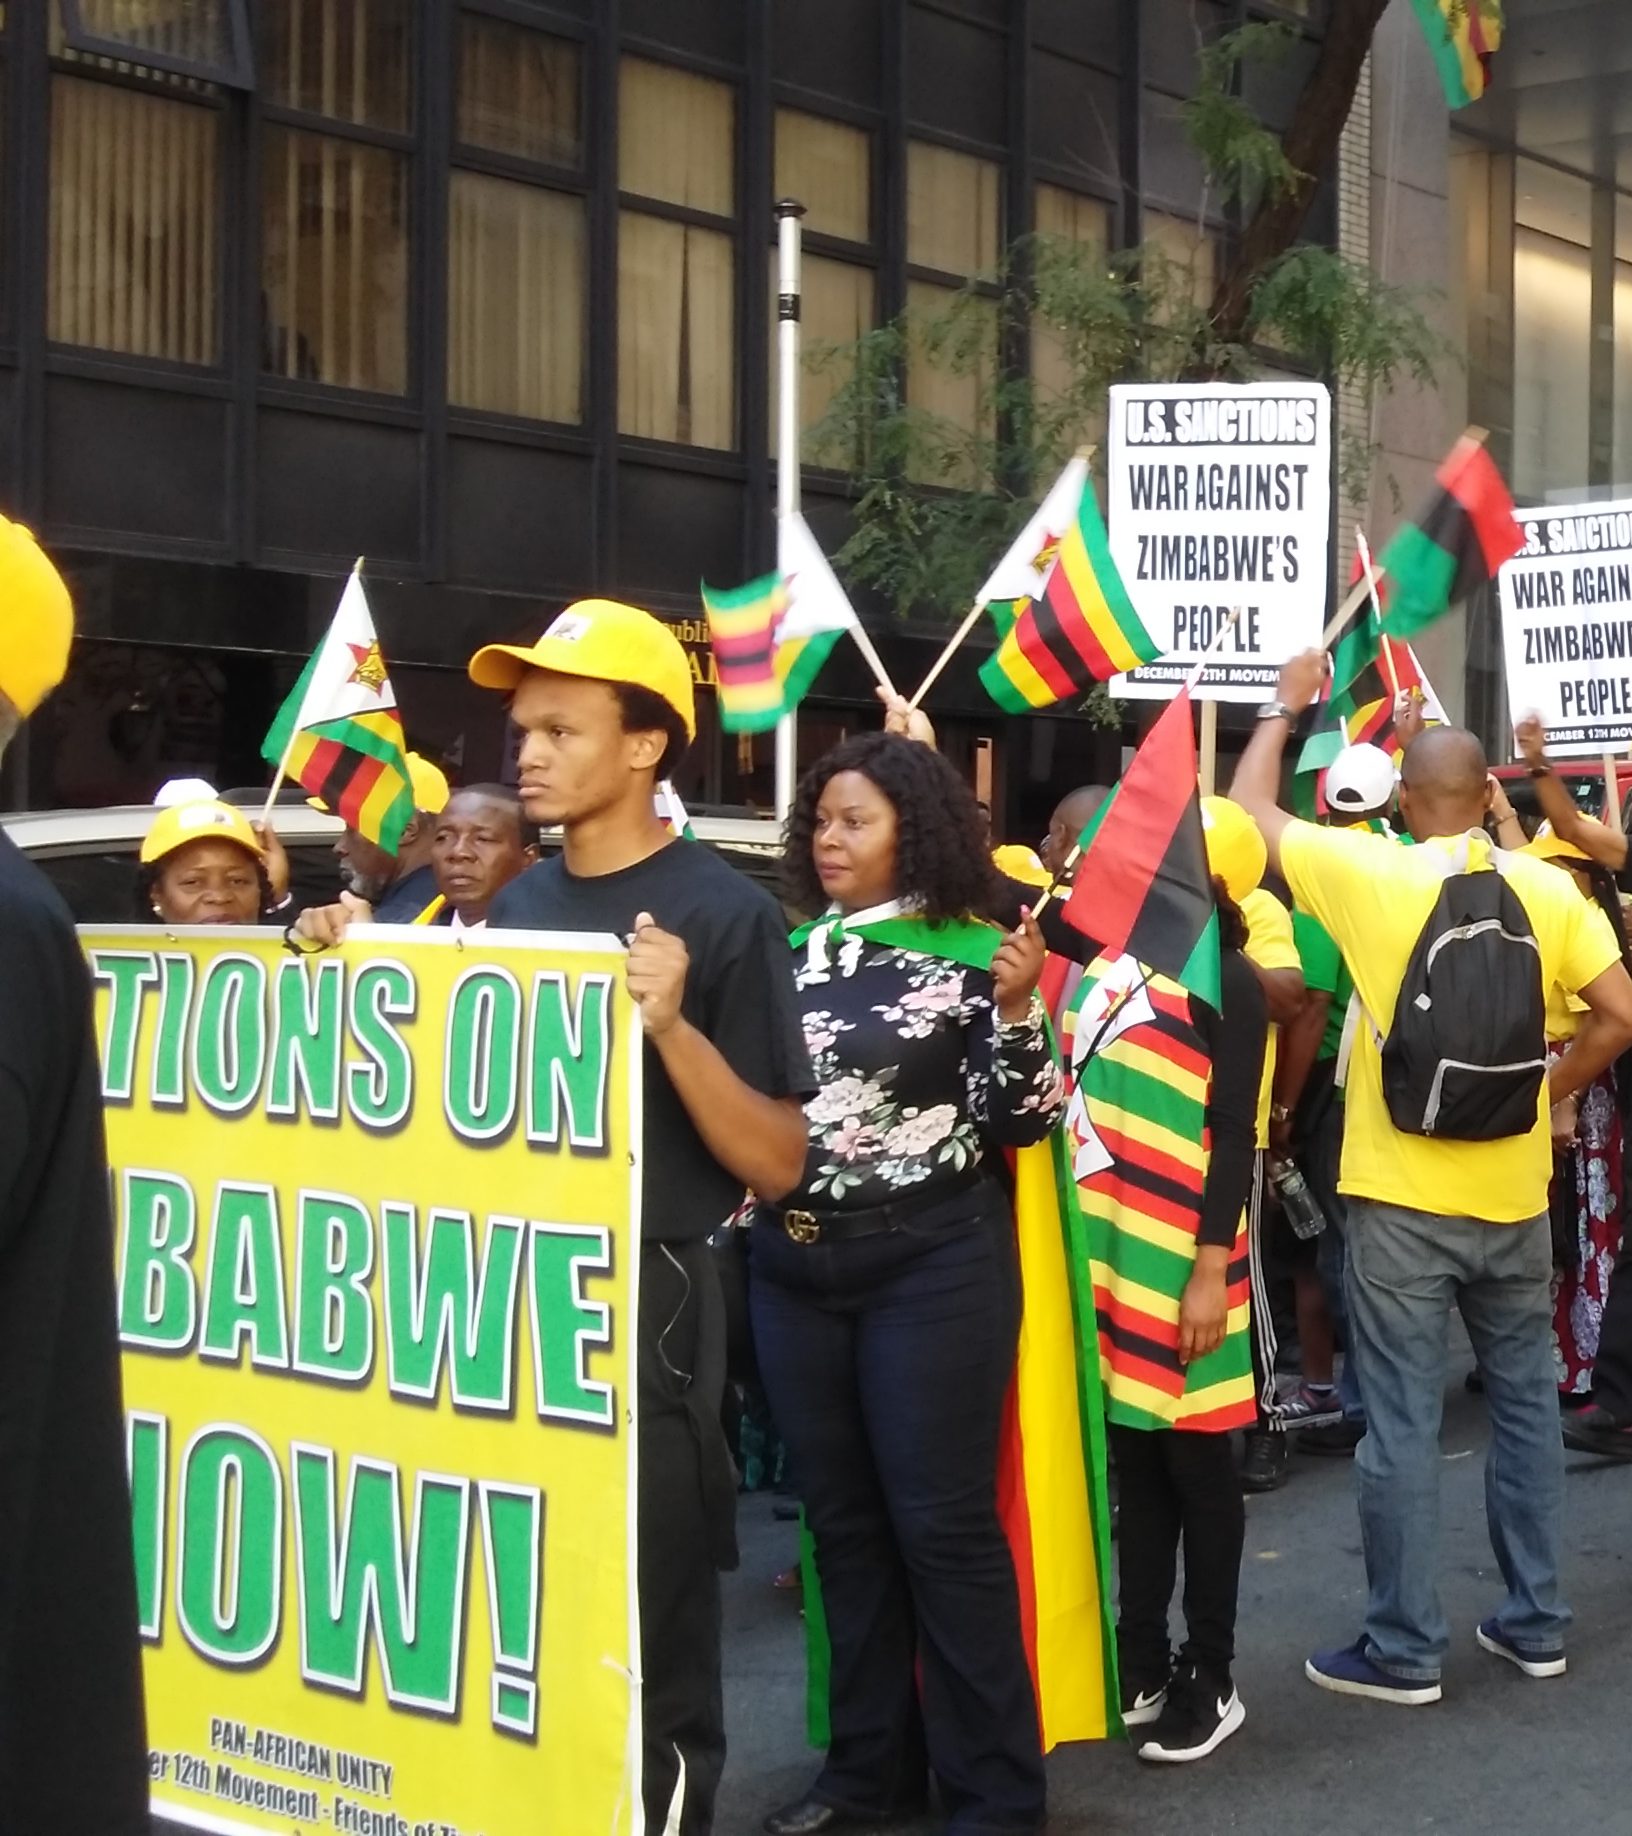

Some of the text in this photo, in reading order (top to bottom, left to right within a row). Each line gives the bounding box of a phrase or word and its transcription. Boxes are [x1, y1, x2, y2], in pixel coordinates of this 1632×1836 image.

[1127, 400, 1315, 443] U.S. SANCTIONS
[1129, 463, 1309, 511] WAR AGAINST
[1137, 534, 1299, 583] ZIMBABWE'S
[1512, 569, 1566, 610] WAR
[1174, 604, 1261, 652] PEOPLE
[1229, 669, 1281, 682] MOVEM
[1560, 676, 1632, 717] PEOPLE
[444, 964, 614, 1148] ON
[211, 1718, 331, 1779] PAN-AFRICAN
[336, 1755, 393, 1796] UNITY
[174, 1752, 211, 1791] 12th
[215, 1764, 318, 1820] Movement
[334, 1797, 409, 1836] Friends
